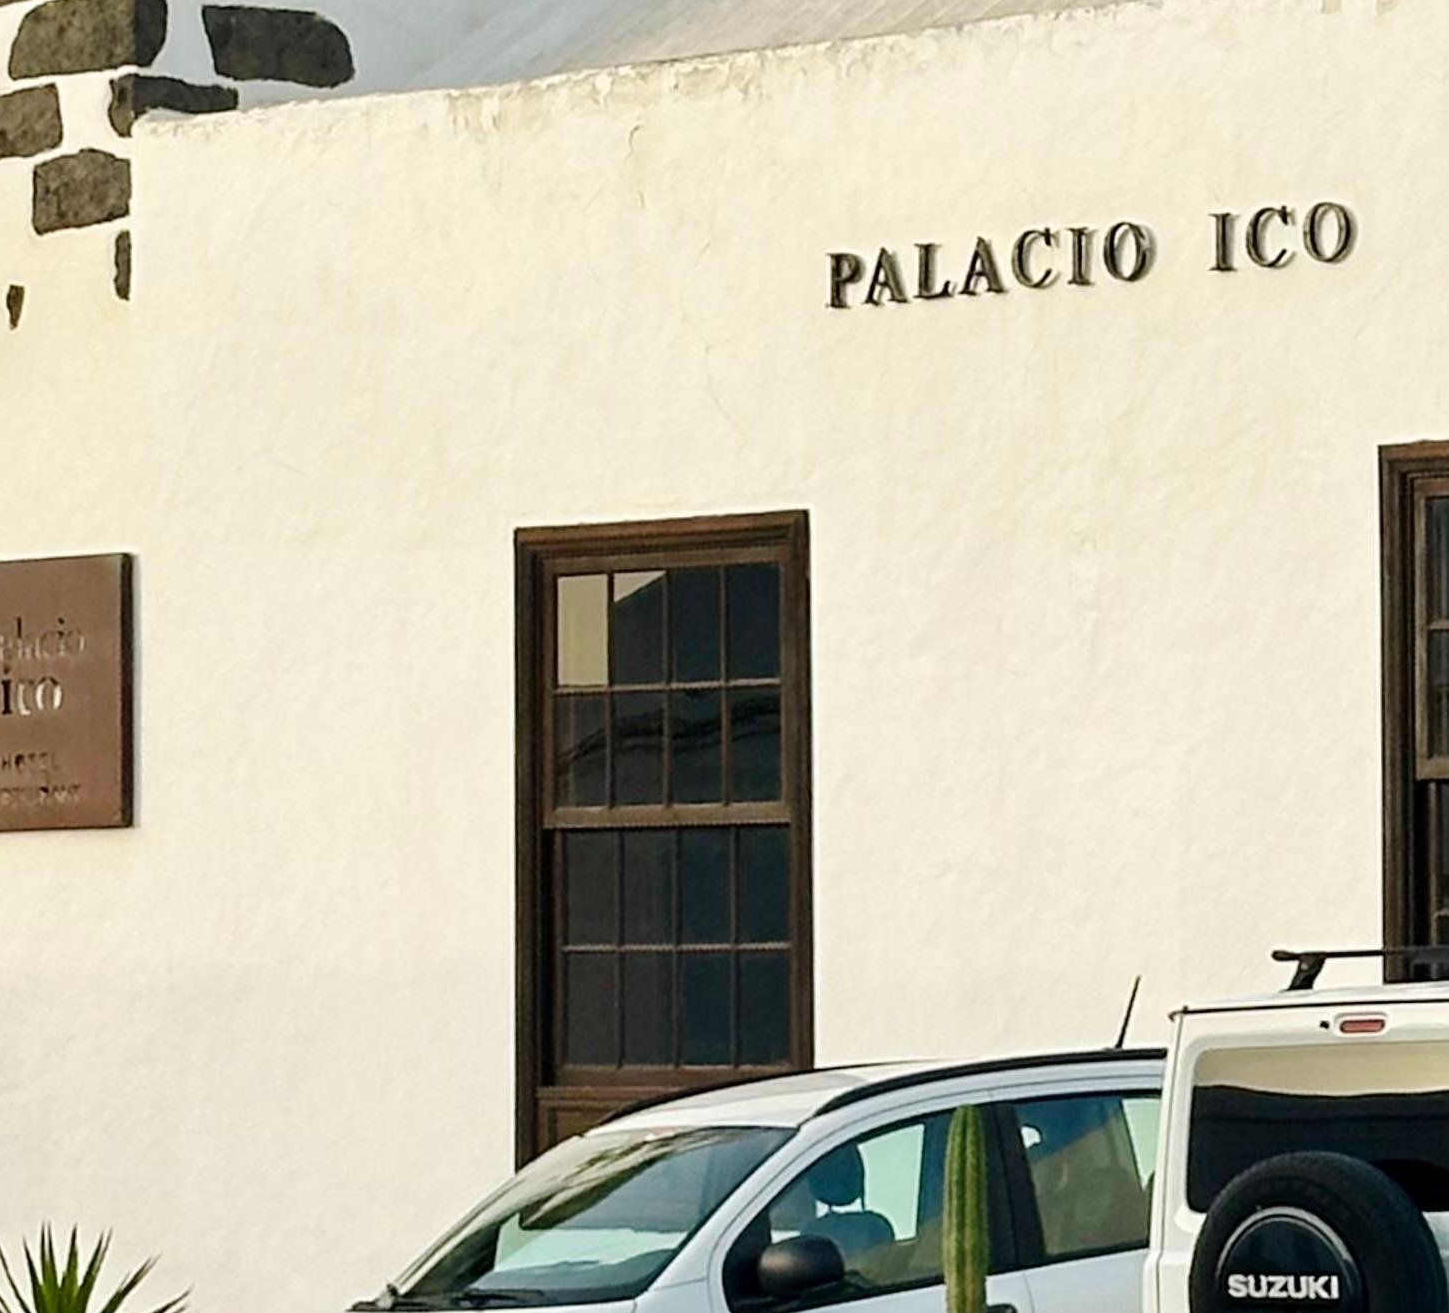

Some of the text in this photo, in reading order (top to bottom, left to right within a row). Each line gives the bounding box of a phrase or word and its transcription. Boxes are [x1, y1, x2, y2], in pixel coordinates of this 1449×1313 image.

[826, 201, 1358, 309] PALACIO ICO
[1227, 1274, 1340, 1299] SUZUKI
